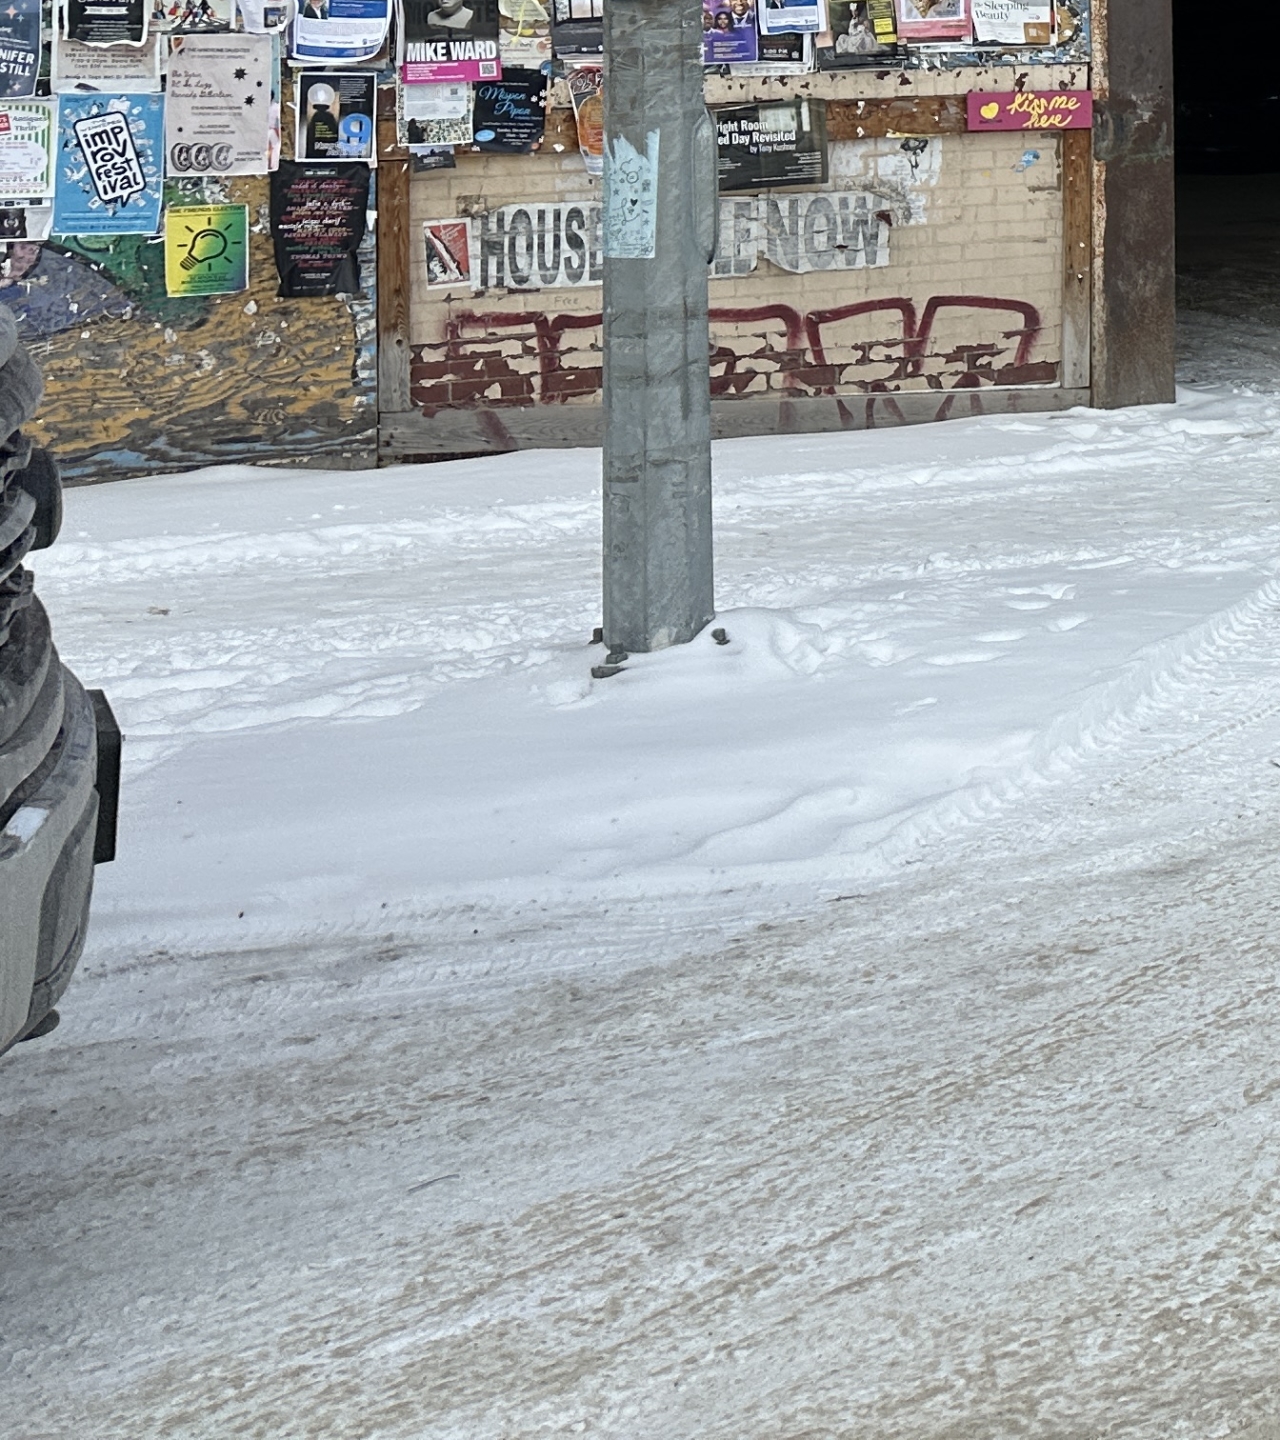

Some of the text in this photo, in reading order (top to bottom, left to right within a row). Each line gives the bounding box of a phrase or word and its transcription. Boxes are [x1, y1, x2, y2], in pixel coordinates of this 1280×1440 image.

[984, 1, 1029, 11] Sleeping
[407, 41, 496, 62] MIKE WARD
[0, 62, 31, 77] STILL
[1006, 92, 1081, 116] Kiss me
[741, 120, 768, 132] Room
[1023, 112, 1073, 129] here
[732, 132, 750, 145] Day
[752, 130, 796, 143] Revisited
[750, 145, 757, 154] by
[759, 144, 772, 153] Tony
[764, 194, 887, 273] NOW
